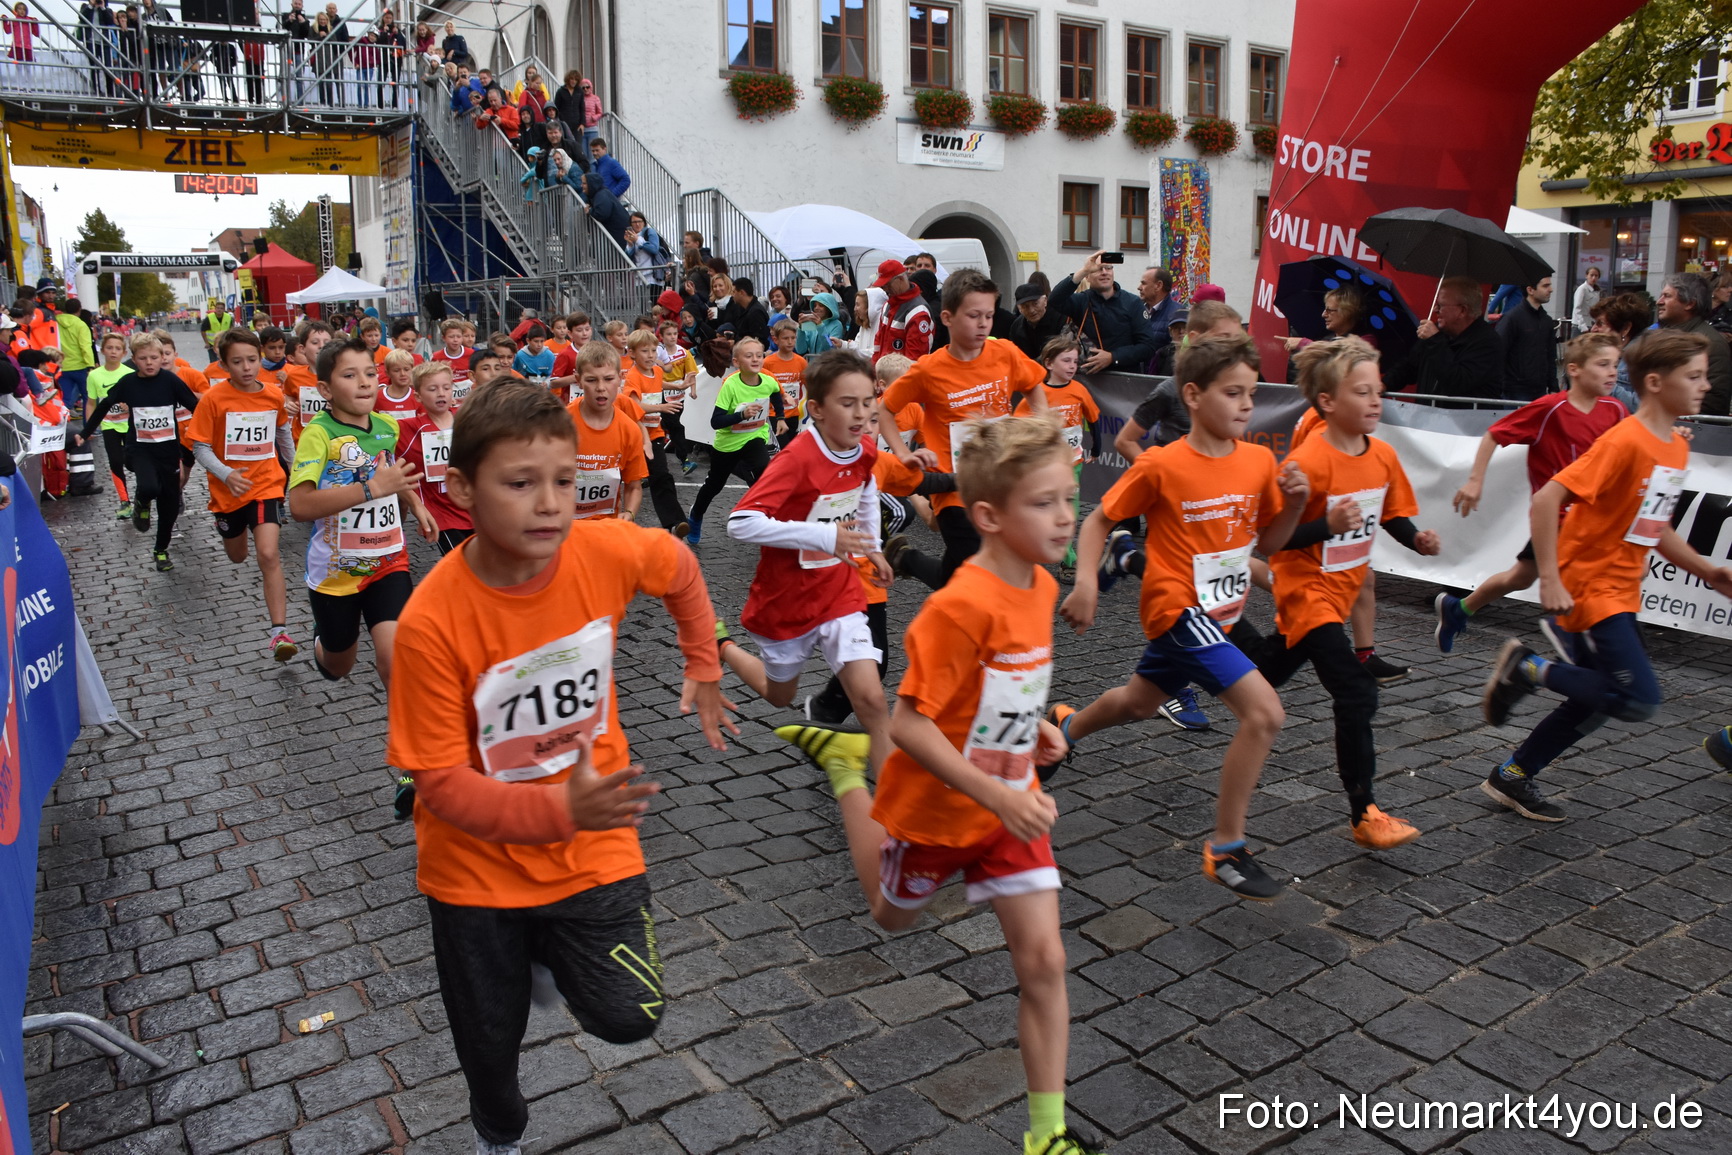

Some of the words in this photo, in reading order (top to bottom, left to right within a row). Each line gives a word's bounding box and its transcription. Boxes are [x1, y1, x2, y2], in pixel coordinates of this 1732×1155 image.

[922, 134, 964, 151] swn
[1650, 138, 1704, 162] Der
[164, 138, 247, 166] ZIEL
[949, 150, 975, 159] neumarkt
[1279, 134, 1371, 182] STORE
[1269, 209, 1378, 262] ONLINE
[111, 256, 139, 266] MINI
[142, 255, 210, 266] NEUMARKT.
[947, 381, 994, 400] Neumarkter
[949, 393, 987, 409] Stadtlauf
[141, 417, 169, 429] 7323
[234, 425, 268, 442] 7151
[575, 485, 610, 501] 166
[1181, 493, 1246, 511] Neumarkter
[351, 503, 395, 529] 7138
[1183, 506, 1236, 523] Stadtlauf
[360, 534, 392, 546] Benjamin
[498, 668, 599, 732] 7183
